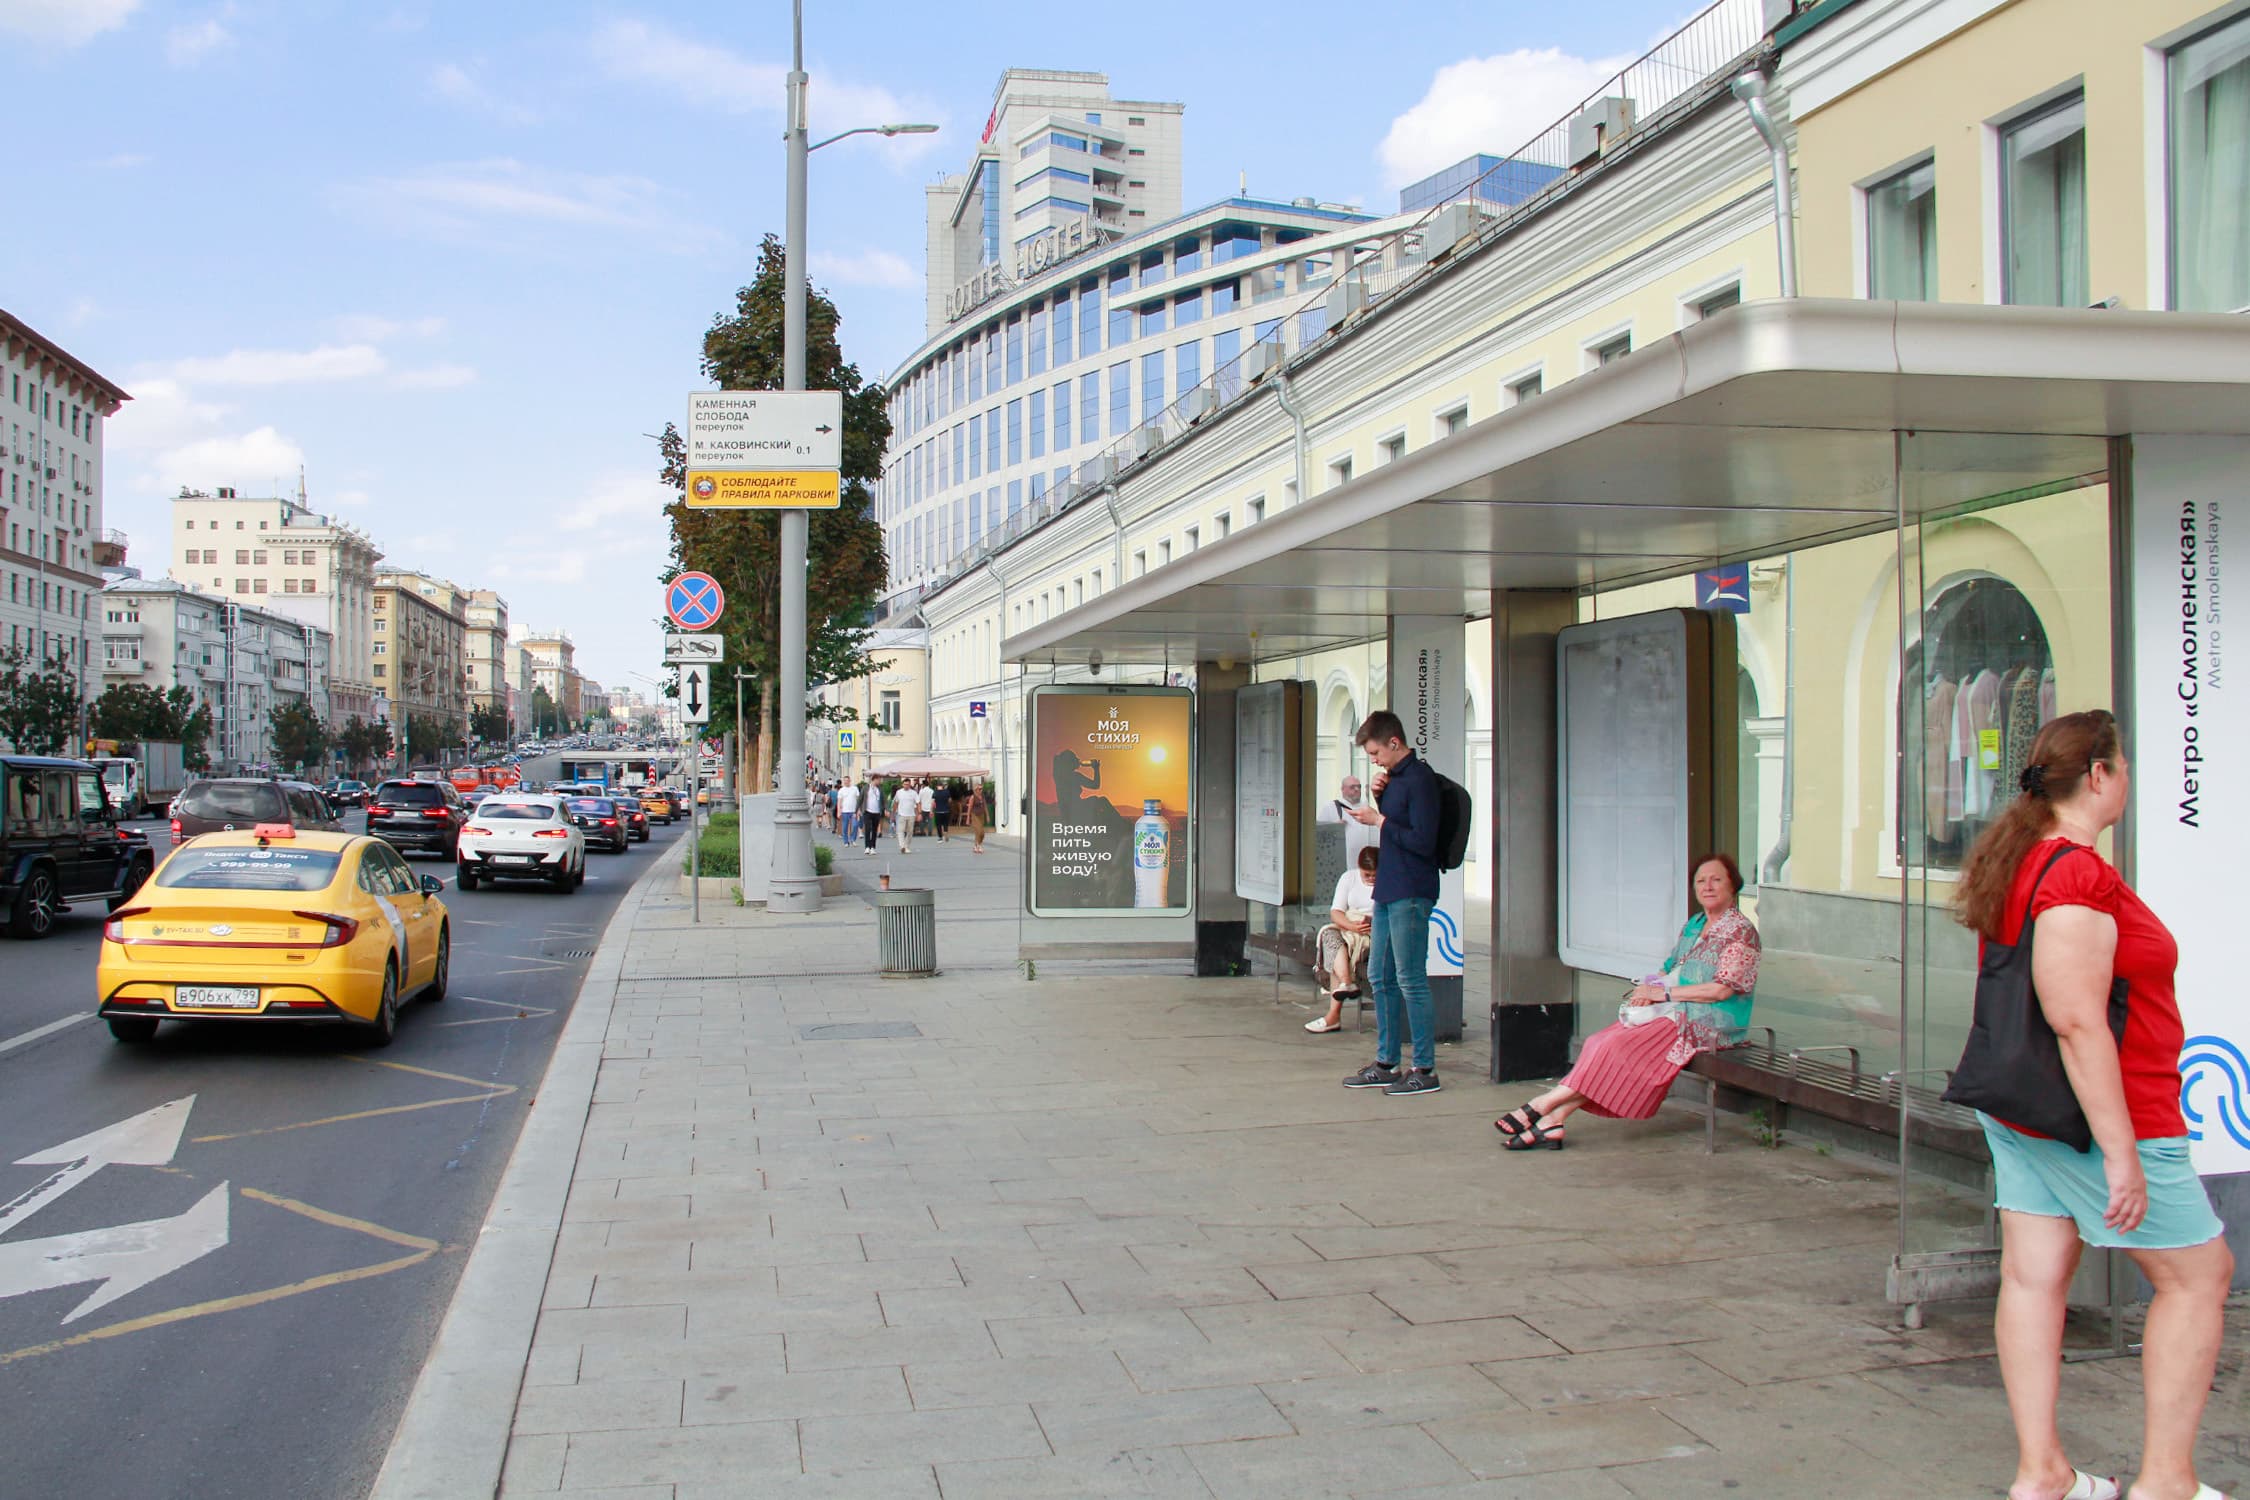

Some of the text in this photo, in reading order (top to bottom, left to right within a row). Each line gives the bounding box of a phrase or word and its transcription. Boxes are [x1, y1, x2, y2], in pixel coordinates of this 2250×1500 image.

[1016, 213, 1097, 279] HOTEL
[695, 400, 757, 409] КАМЕННАЯ
[695, 412, 750, 422] СЛОБОДА
[695, 424, 745, 432] переулок
[710, 439, 792, 450] КАКОВИНСКИЙ
[796, 446, 811, 455] 0.1
[695, 453, 744, 461] переулок
[721, 476, 798, 488] СОБЛЮДАЙТЕ
[721, 490, 835, 500] ПРАВИЛА ПАРКОВКИ!
[2205, 501, 2223, 689] Metro Smolenskaya
[2177, 499, 2203, 829] Метро «Смоленская»
[1431, 648, 1441, 741] Metro Smolenskaya
[1415, 648, 1428, 754] «Смоленская»
[1097, 720, 1130, 732] МОЯ
[1087, 733, 1140, 744] СТИХИЯ
[1052, 823, 1107, 835] Время
[1052, 838, 1092, 848] пить
[1052, 851, 1112, 862] живую
[1052, 863, 1098, 876] воду!
[235, 989, 256, 1000] 799
